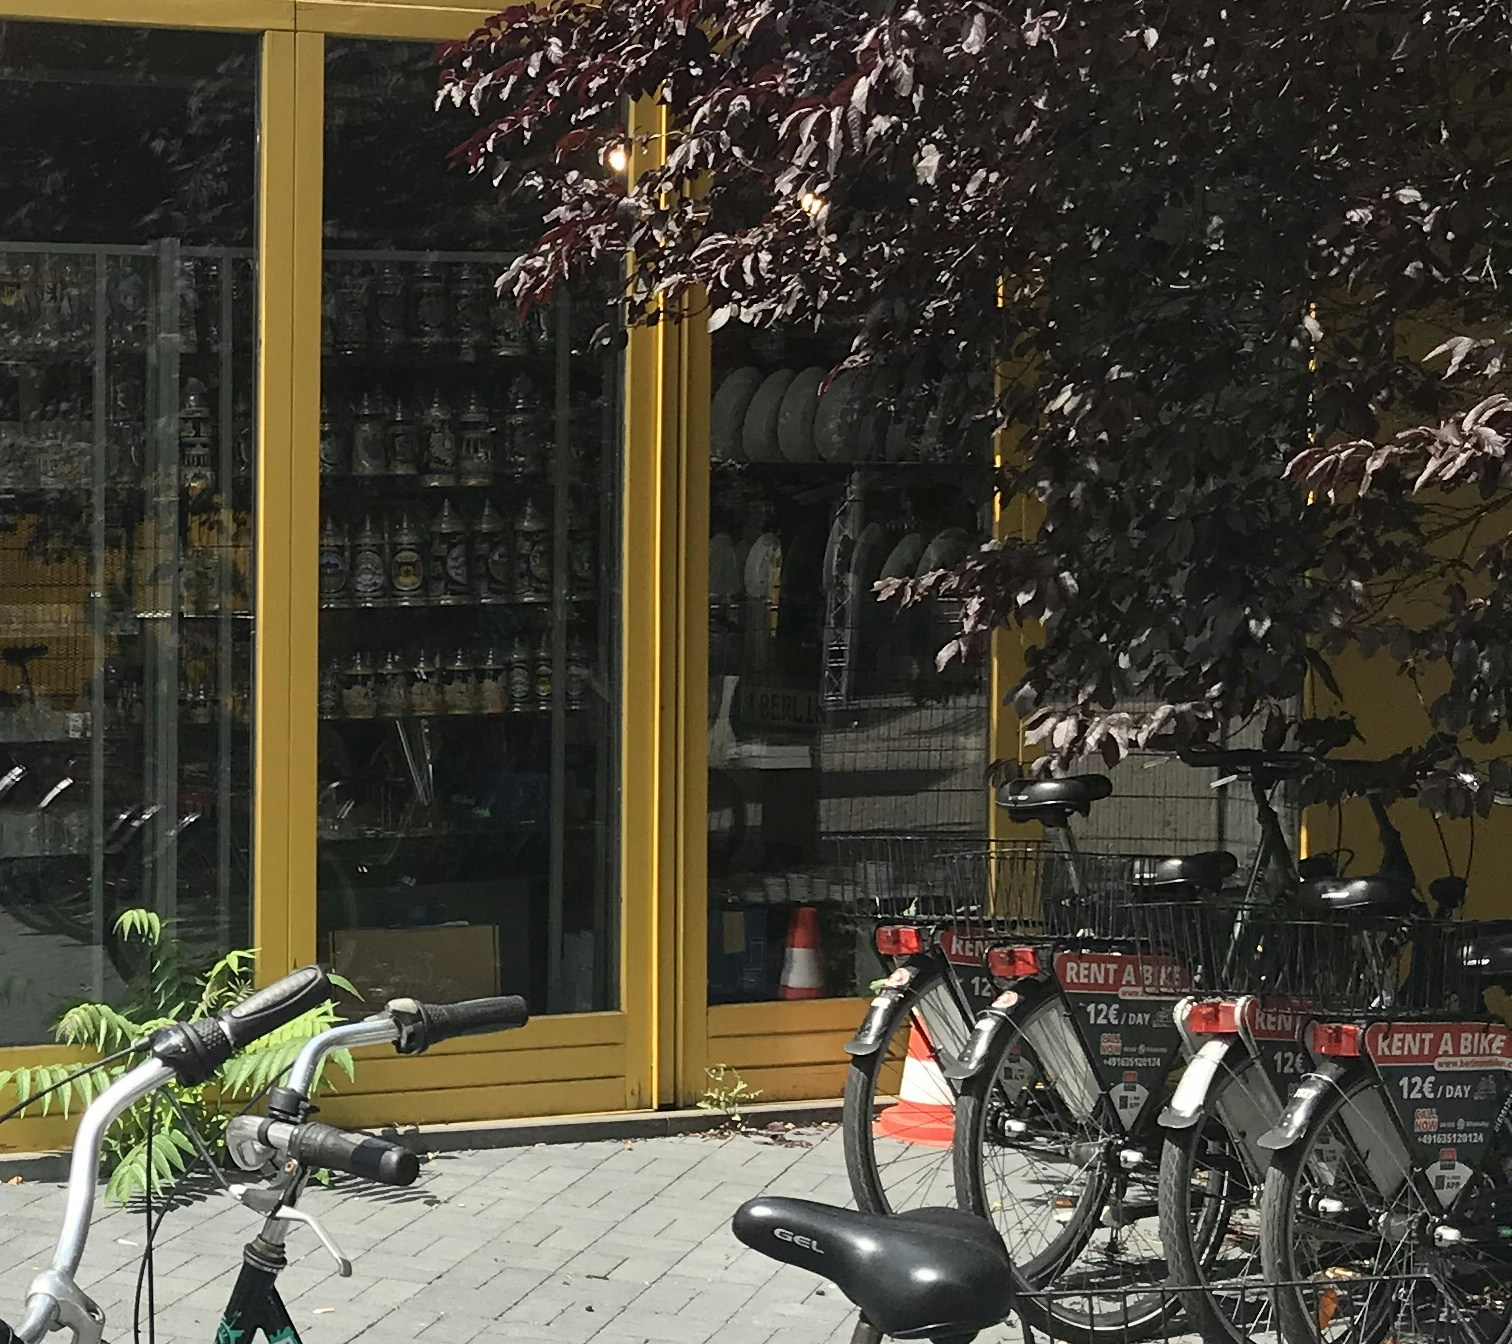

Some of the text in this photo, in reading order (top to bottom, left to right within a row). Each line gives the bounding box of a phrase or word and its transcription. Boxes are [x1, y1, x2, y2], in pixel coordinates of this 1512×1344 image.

[951, 935, 986, 956] REN
[1066, 963, 1118, 985] RENT
[1121, 964, 1136, 985] A
[971, 975, 992, 998] 12
[1086, 1003, 1119, 1025] 12€
[1129, 1013, 1150, 1026] DAY
[1377, 1032, 1508, 1056] RENT A BIKE
[1273, 1050, 1305, 1074] 12€
[1398, 1076, 1436, 1099] 12€
[1445, 1085, 1471, 1098] DAY
[773, 1227, 825, 1254] GEL
